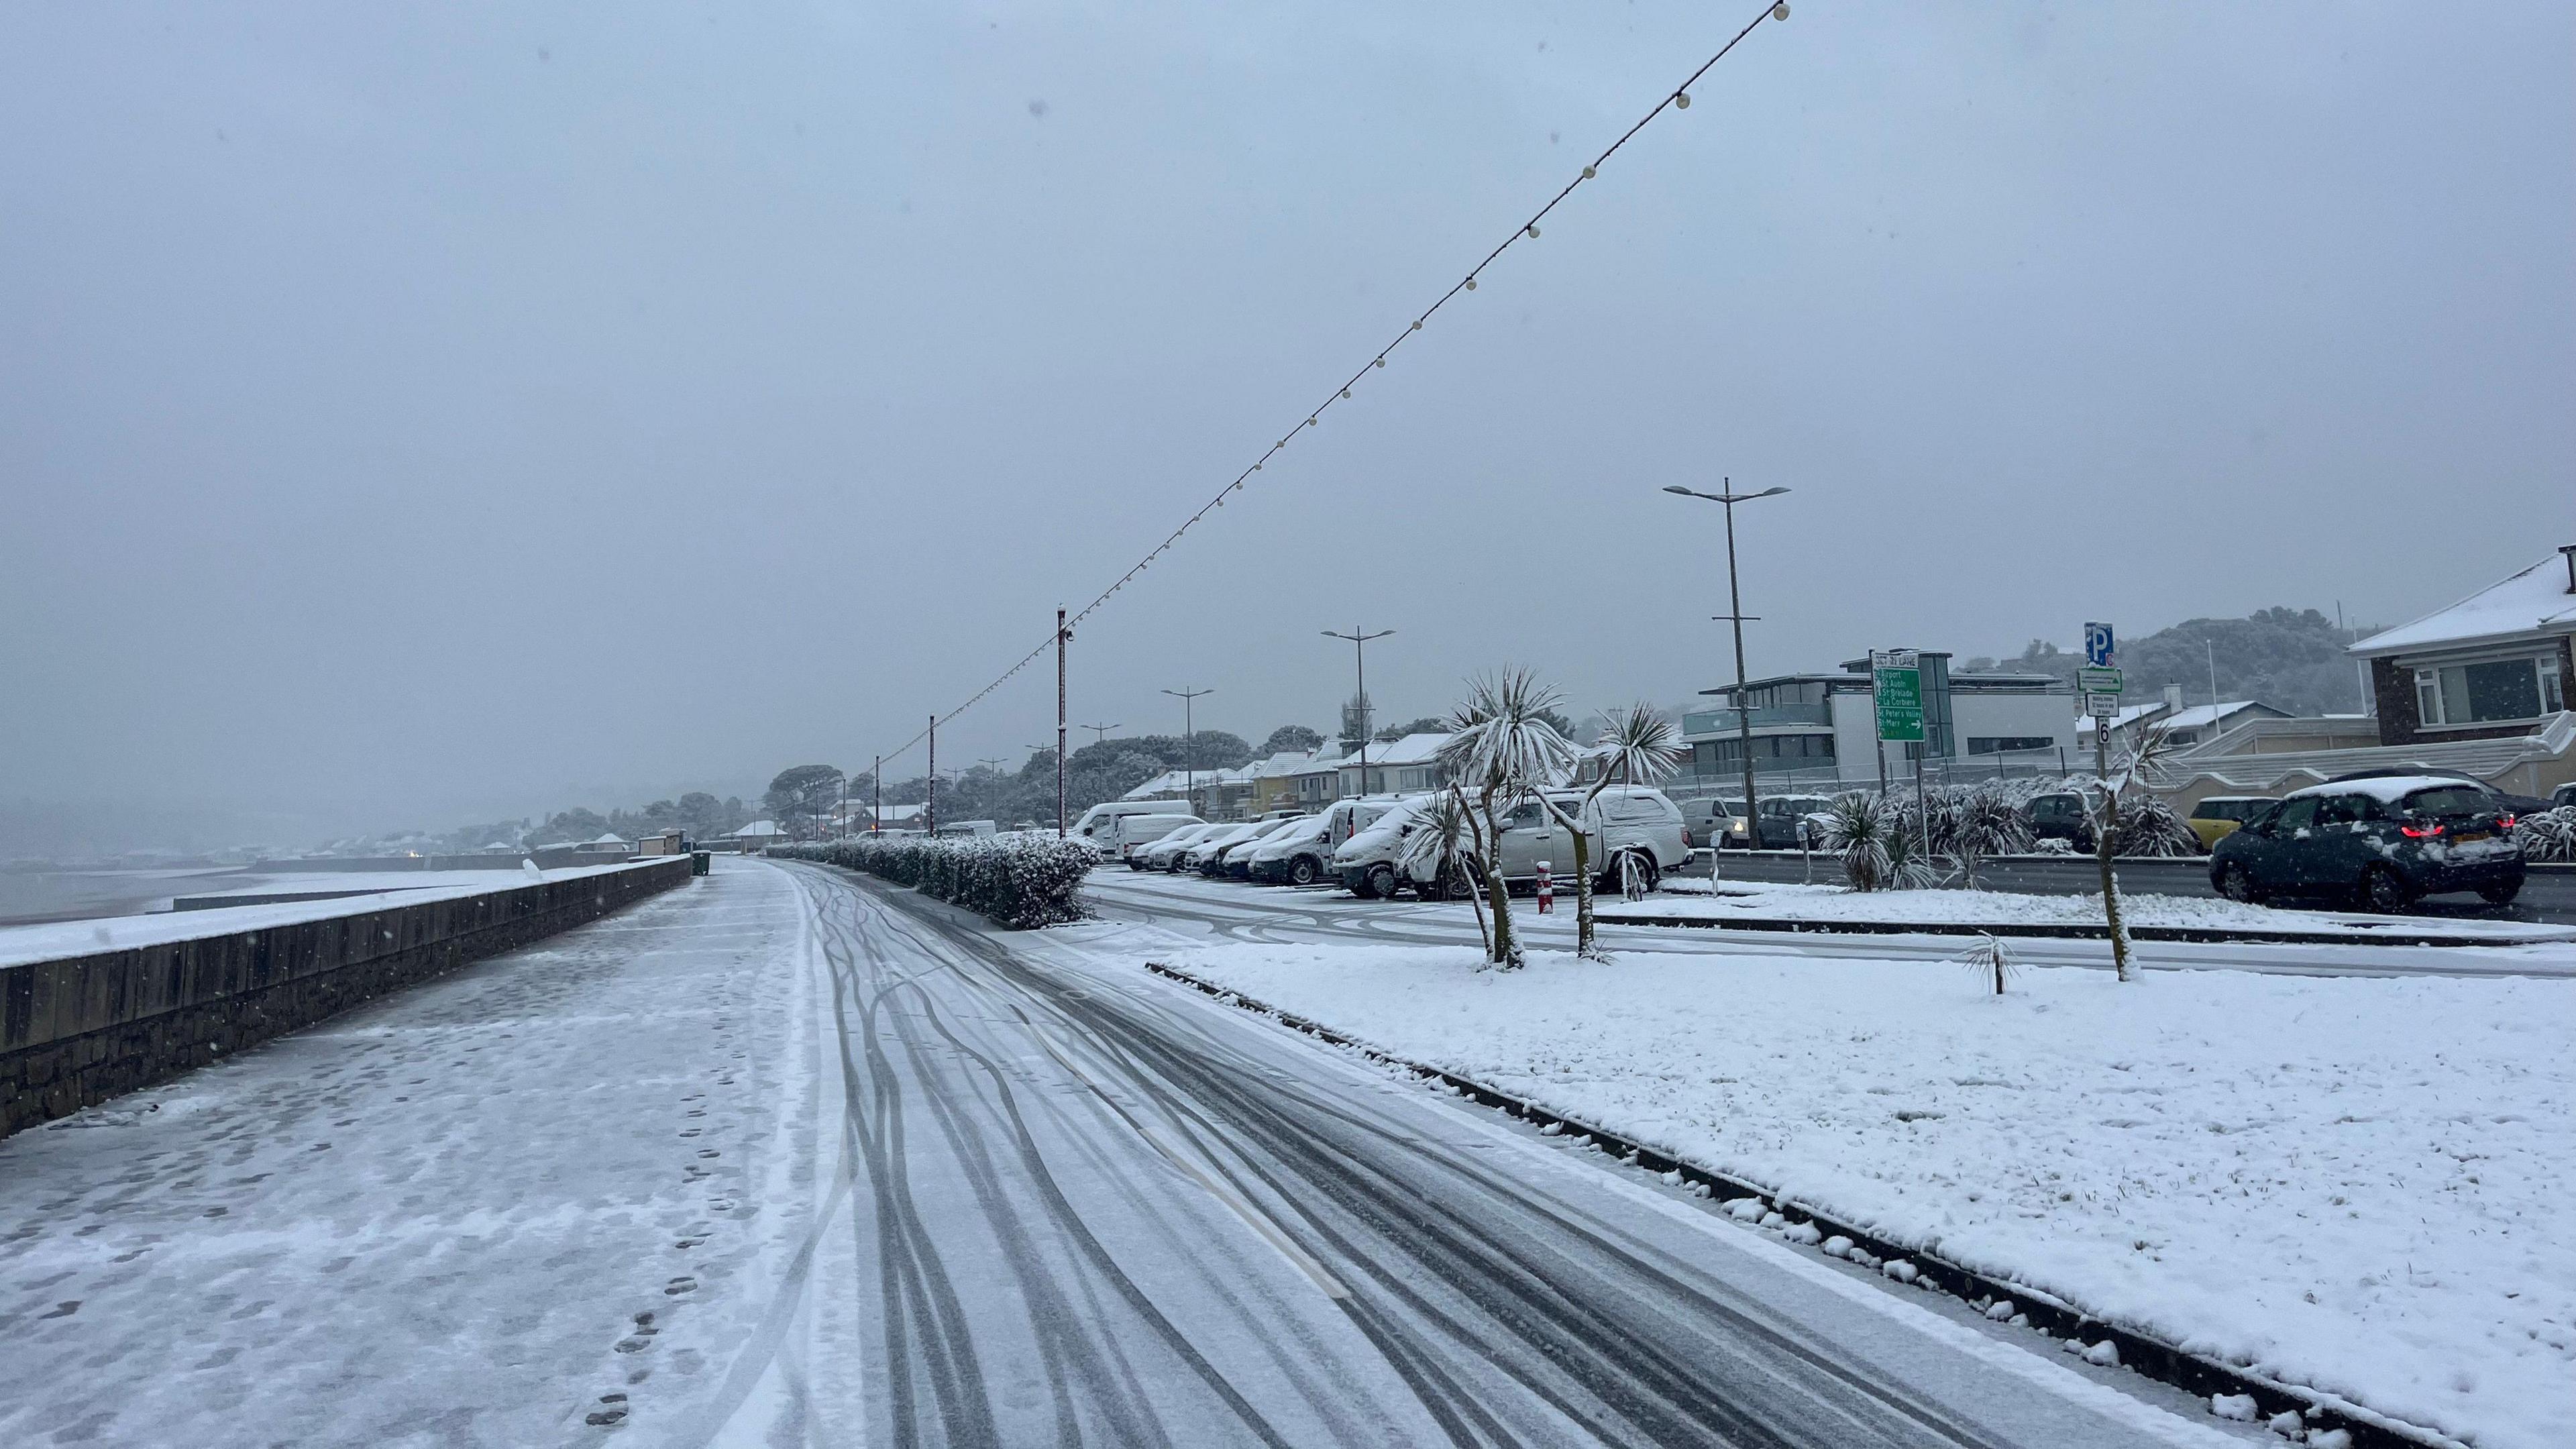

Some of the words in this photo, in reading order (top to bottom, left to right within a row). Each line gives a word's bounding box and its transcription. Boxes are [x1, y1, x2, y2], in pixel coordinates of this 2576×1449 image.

[2092, 627, 2108, 661] P
[1899, 657, 1915, 665] LANE
[1881, 670, 1901, 680] Airport
[1890, 680, 1906, 688] Aubin
[1906, 710, 1921, 718] Valley
[2100, 724, 2109, 742] 6
